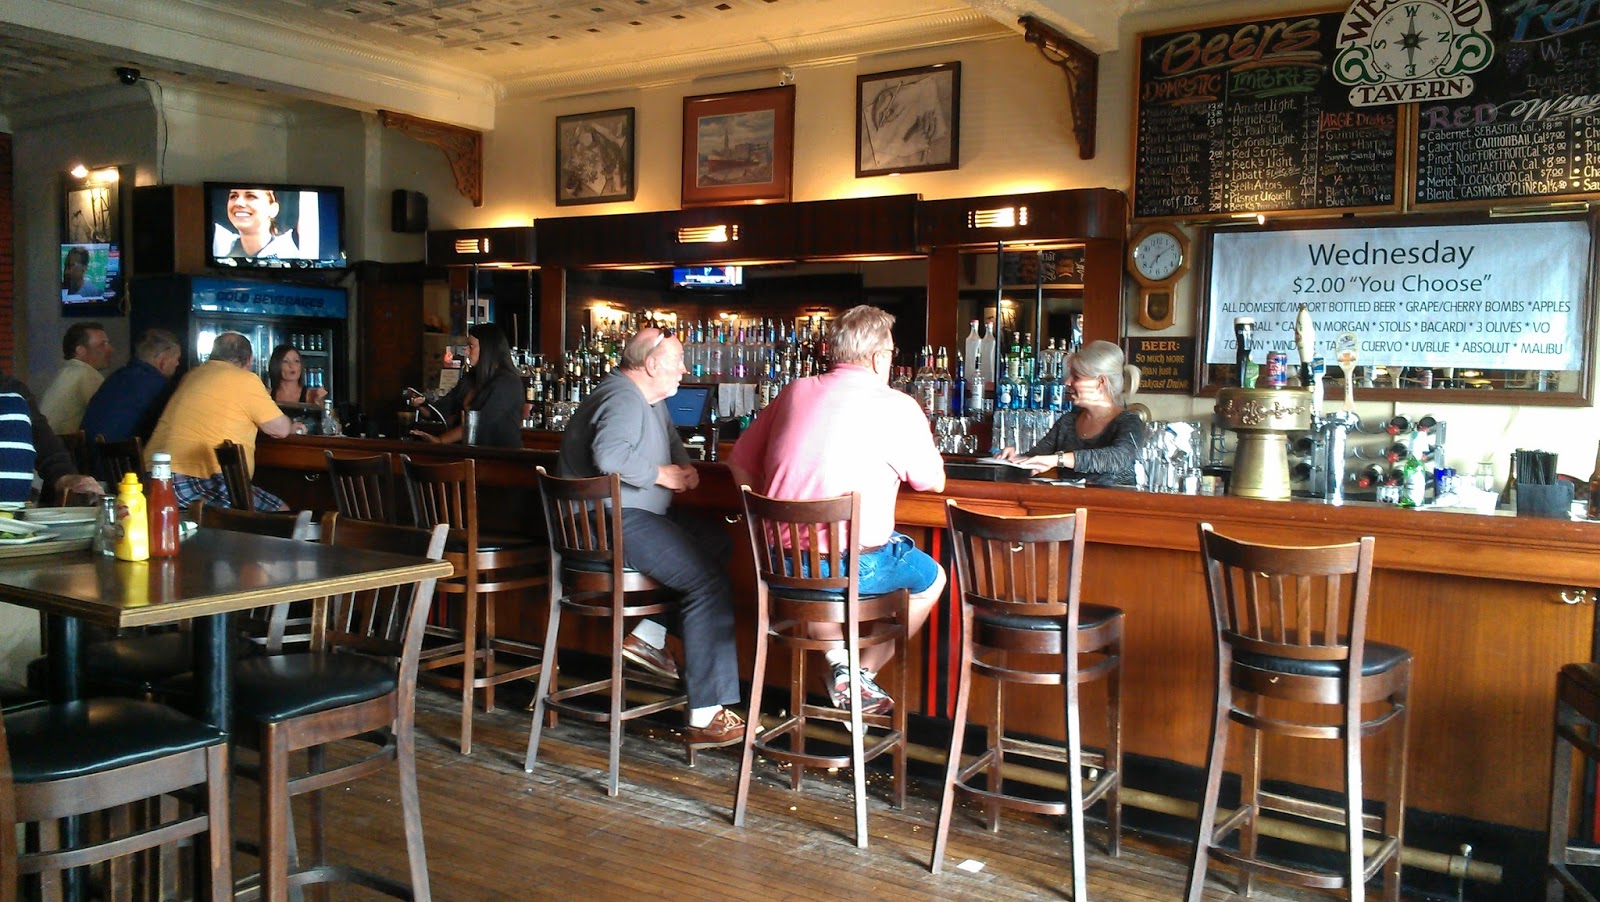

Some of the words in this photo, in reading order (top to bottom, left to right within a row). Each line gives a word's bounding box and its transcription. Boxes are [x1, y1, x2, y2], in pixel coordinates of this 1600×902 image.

[1150, 18, 1320, 75] Beers
[1357, 78, 1465, 104] TAVERN
[1423, 103, 1498, 131] RED
[1232, 148, 1250, 159] Red
[1308, 240, 1475, 269] Wednesday
[1292, 276, 1345, 295] $2.00
[253, 293, 325, 308] BEVERAGES
[1222, 302, 1238, 313] ALL
[1329, 301, 1371, 312] BOTTLED
[1374, 301, 1396, 312] BEER
[1405, 301, 1482, 312] GRAPE/CHERRY
[1485, 301, 1525, 312] BOMBS
[1281, 321, 1321, 332] CAIN
[1323, 320, 1370, 332] MORGAN
[1421, 321, 1467, 333] BACARDI
[1476, 321, 1483, 333] 3
[1485, 321, 1522, 333] OLIVES
[1533, 322, 1551, 333] VO
[1141, 341, 1180, 351] BEER:
[1223, 340, 1264, 350] 7CWN
[1361, 340, 1402, 352] CUERVO
[1411, 341, 1450, 353] UVBLUE
[1462, 342, 1511, 354] ABSOLUT
[1521, 343, 1563, 355] MALIBU
